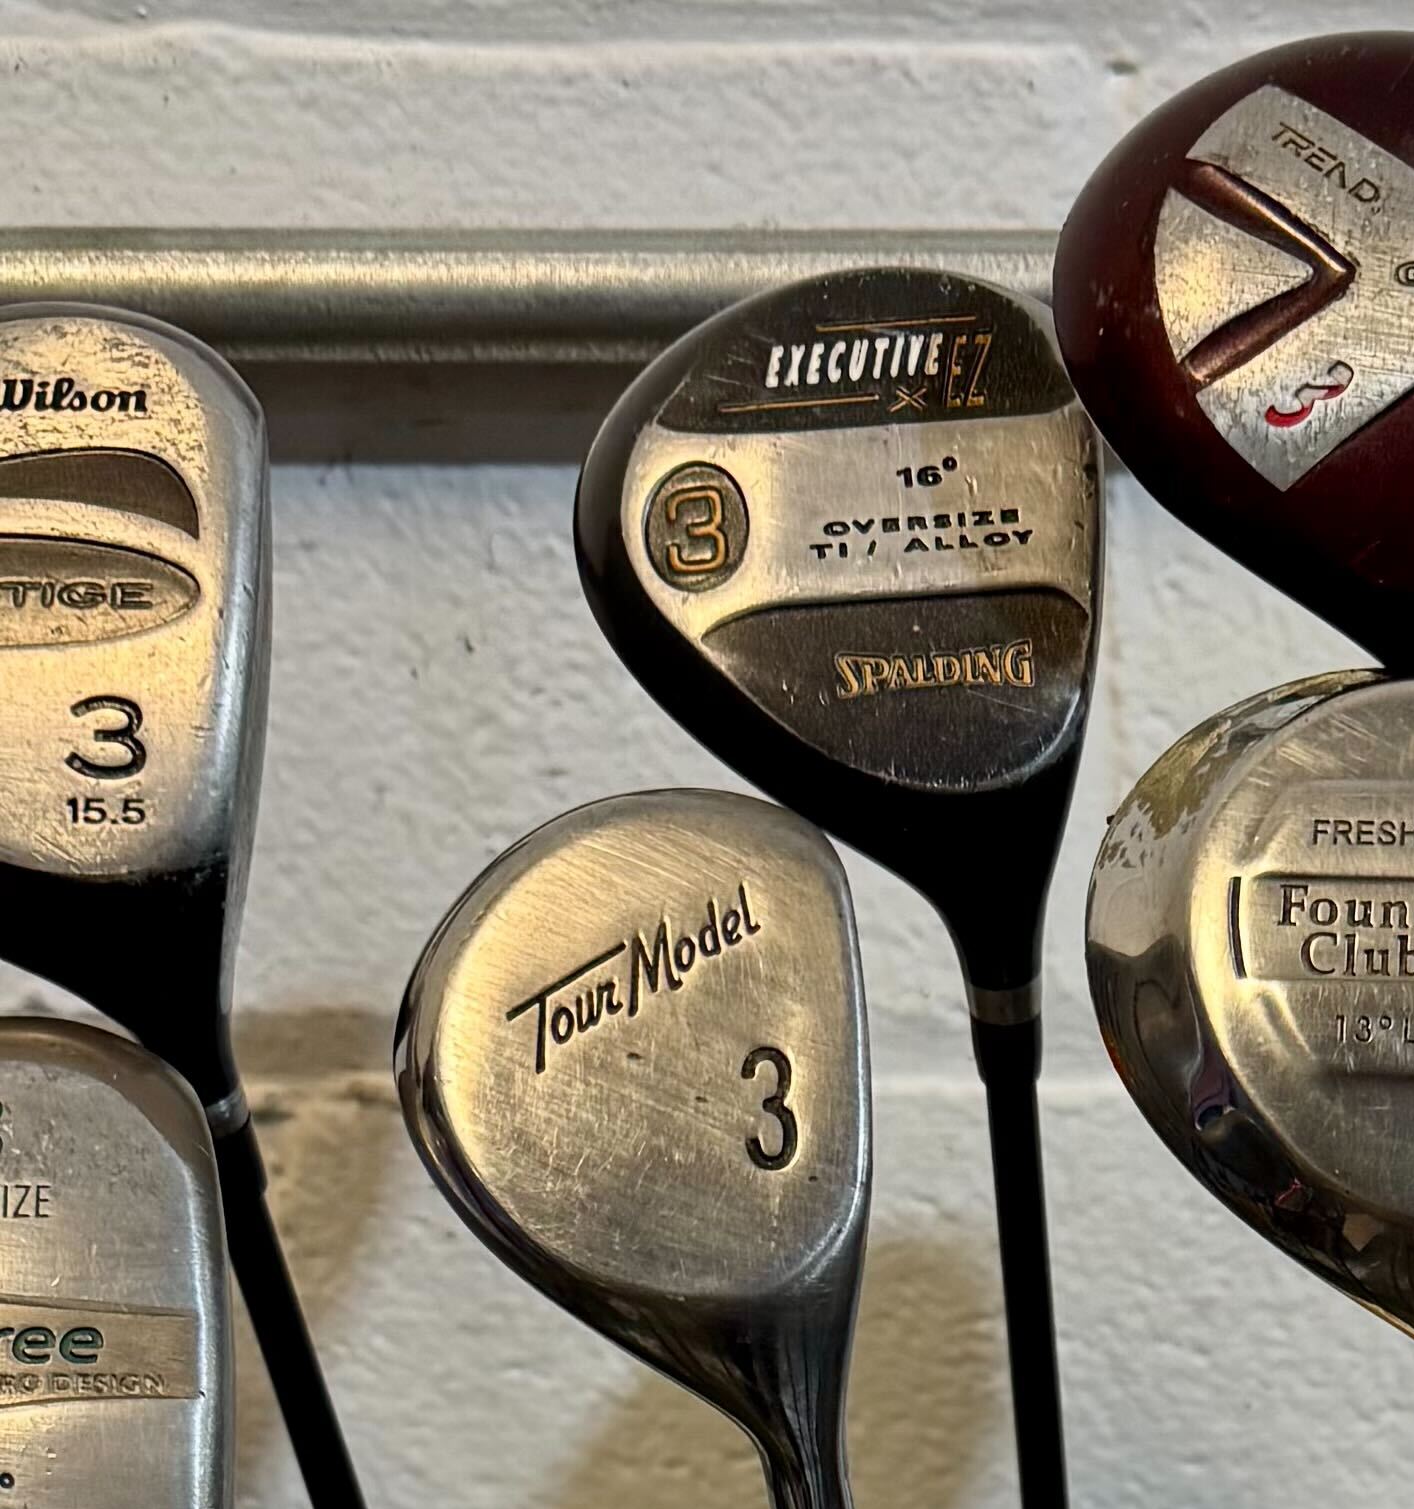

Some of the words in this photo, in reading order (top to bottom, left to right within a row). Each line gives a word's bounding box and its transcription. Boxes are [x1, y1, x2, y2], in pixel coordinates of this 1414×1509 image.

[765, 332, 944, 388] EXECUTIVE
[667, 484, 729, 573] 3
[823, 508, 1019, 537] OVERSIZE
[904, 529, 1033, 553] ALLOY
[835, 639, 1036, 699] SPALDING
[64, 695, 146, 780] 3
[67, 799, 146, 825] 15.5
[506, 940, 628, 1075] Tour
[628, 880, 761, 1017] Model
[740, 1046, 798, 1171] 3
